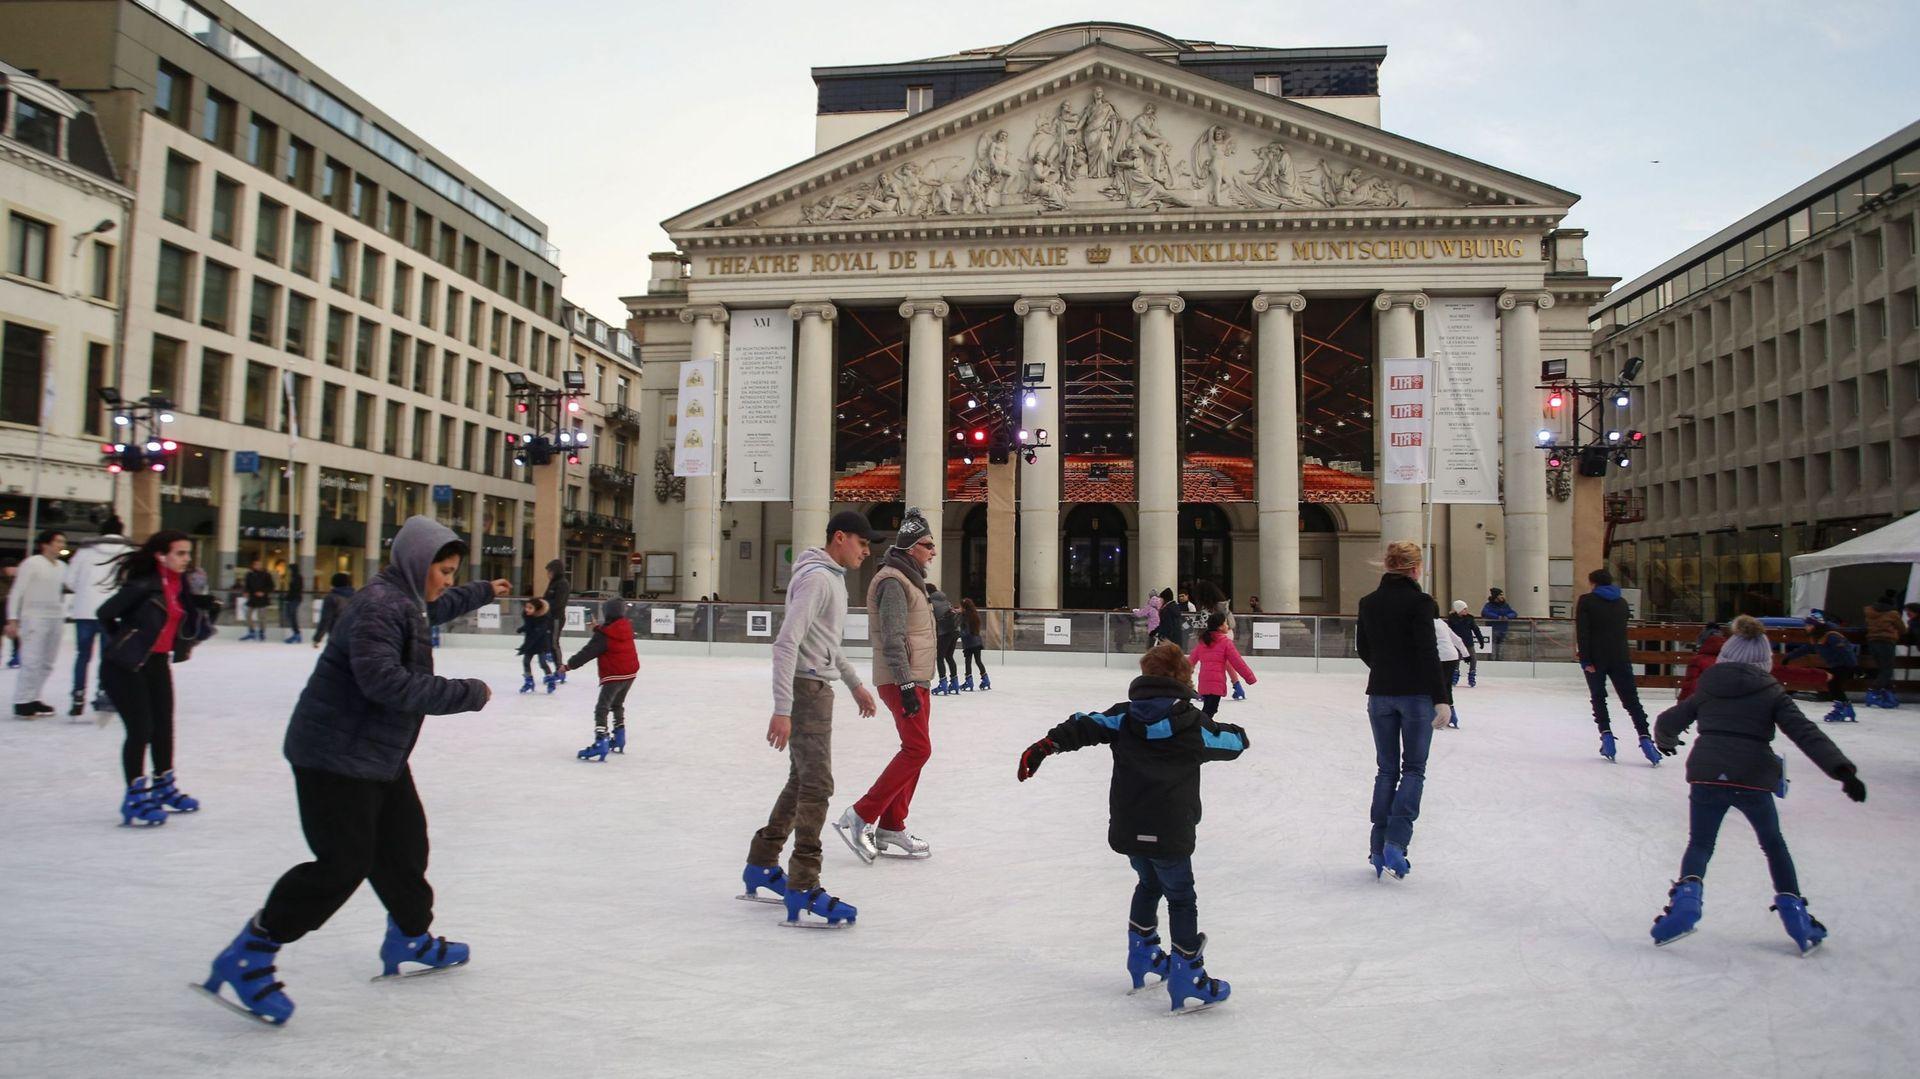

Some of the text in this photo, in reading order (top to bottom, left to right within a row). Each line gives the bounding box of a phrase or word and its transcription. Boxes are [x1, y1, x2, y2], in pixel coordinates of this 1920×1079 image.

[706, 247, 1069, 275] THEATRE ROYAL DE LA MONNAIE
[1129, 238, 1524, 264] KONINKLIJKE MUNTSCHOUWBURG
